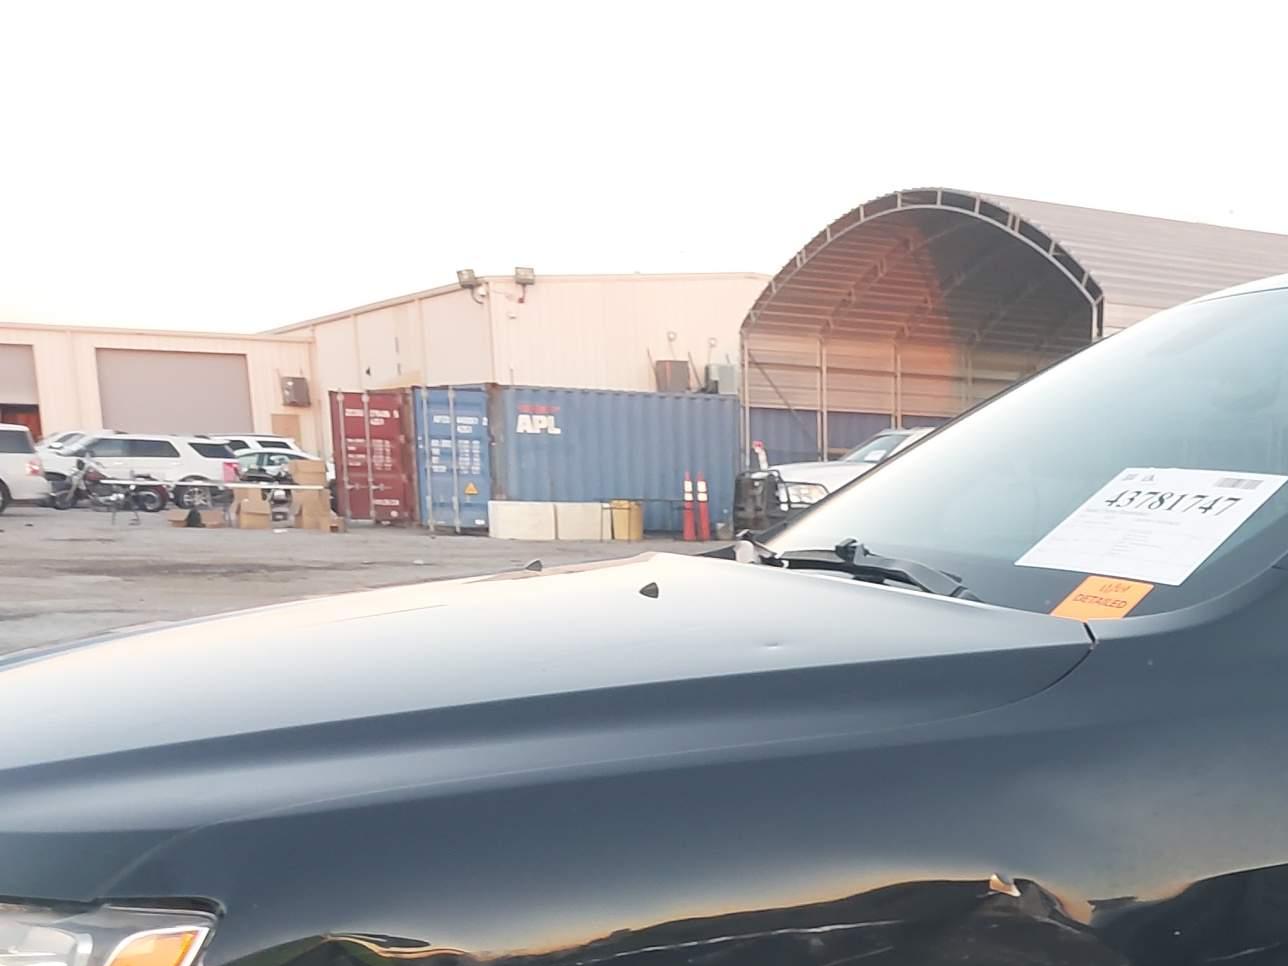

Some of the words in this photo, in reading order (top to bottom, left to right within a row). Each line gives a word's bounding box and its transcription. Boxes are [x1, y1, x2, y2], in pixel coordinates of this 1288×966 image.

[516, 414, 561, 434] APL
[1104, 489, 1241, 515] 43781747
[1072, 593, 1128, 609] DETAILED
